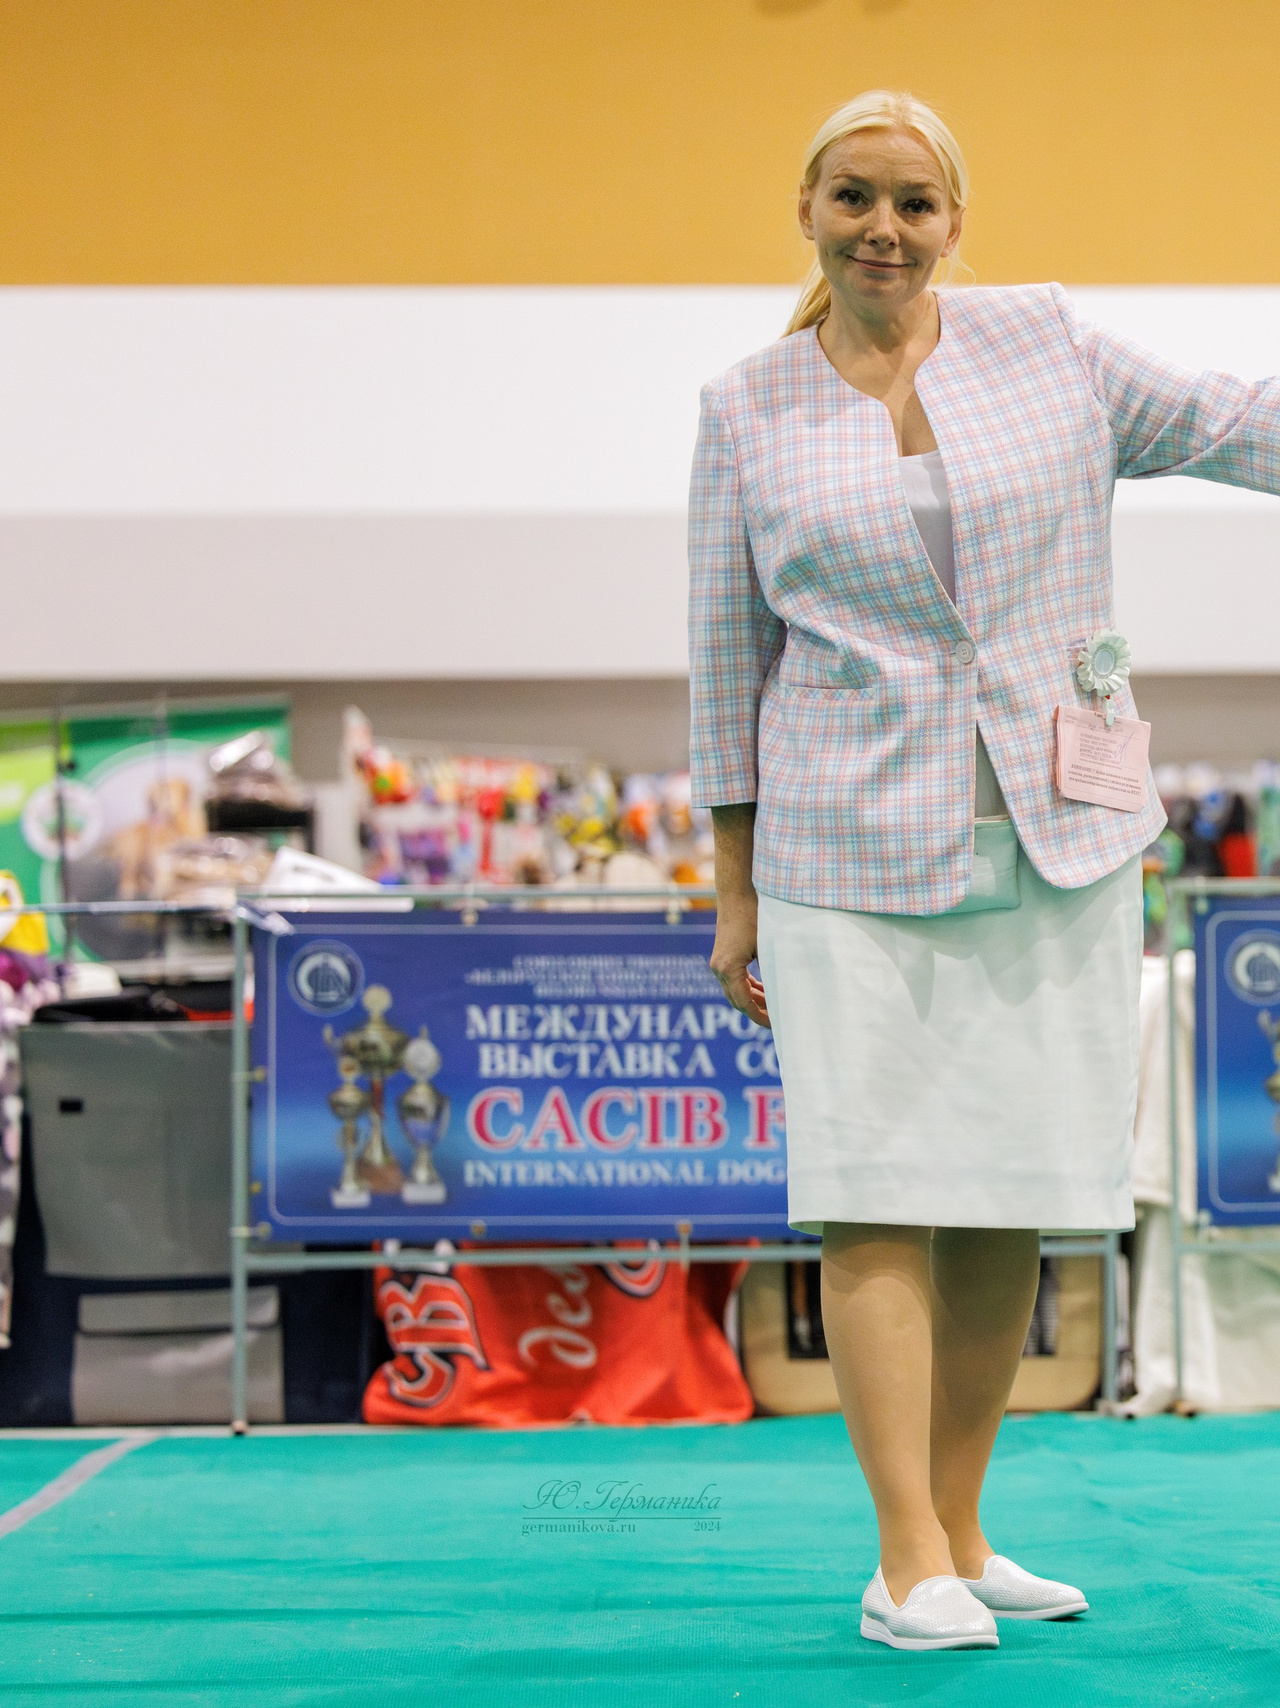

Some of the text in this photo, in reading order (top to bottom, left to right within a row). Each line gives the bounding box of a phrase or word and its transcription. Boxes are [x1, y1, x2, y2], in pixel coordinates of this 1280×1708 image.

[466, 1004, 773, 1041] МЕЖДУНАРО
[479, 1042, 716, 1078] ВЫСТАВКА
[467, 1086, 730, 1152] CACIB
[463, 1159, 785, 1187] INTERNATIONAL DOG
